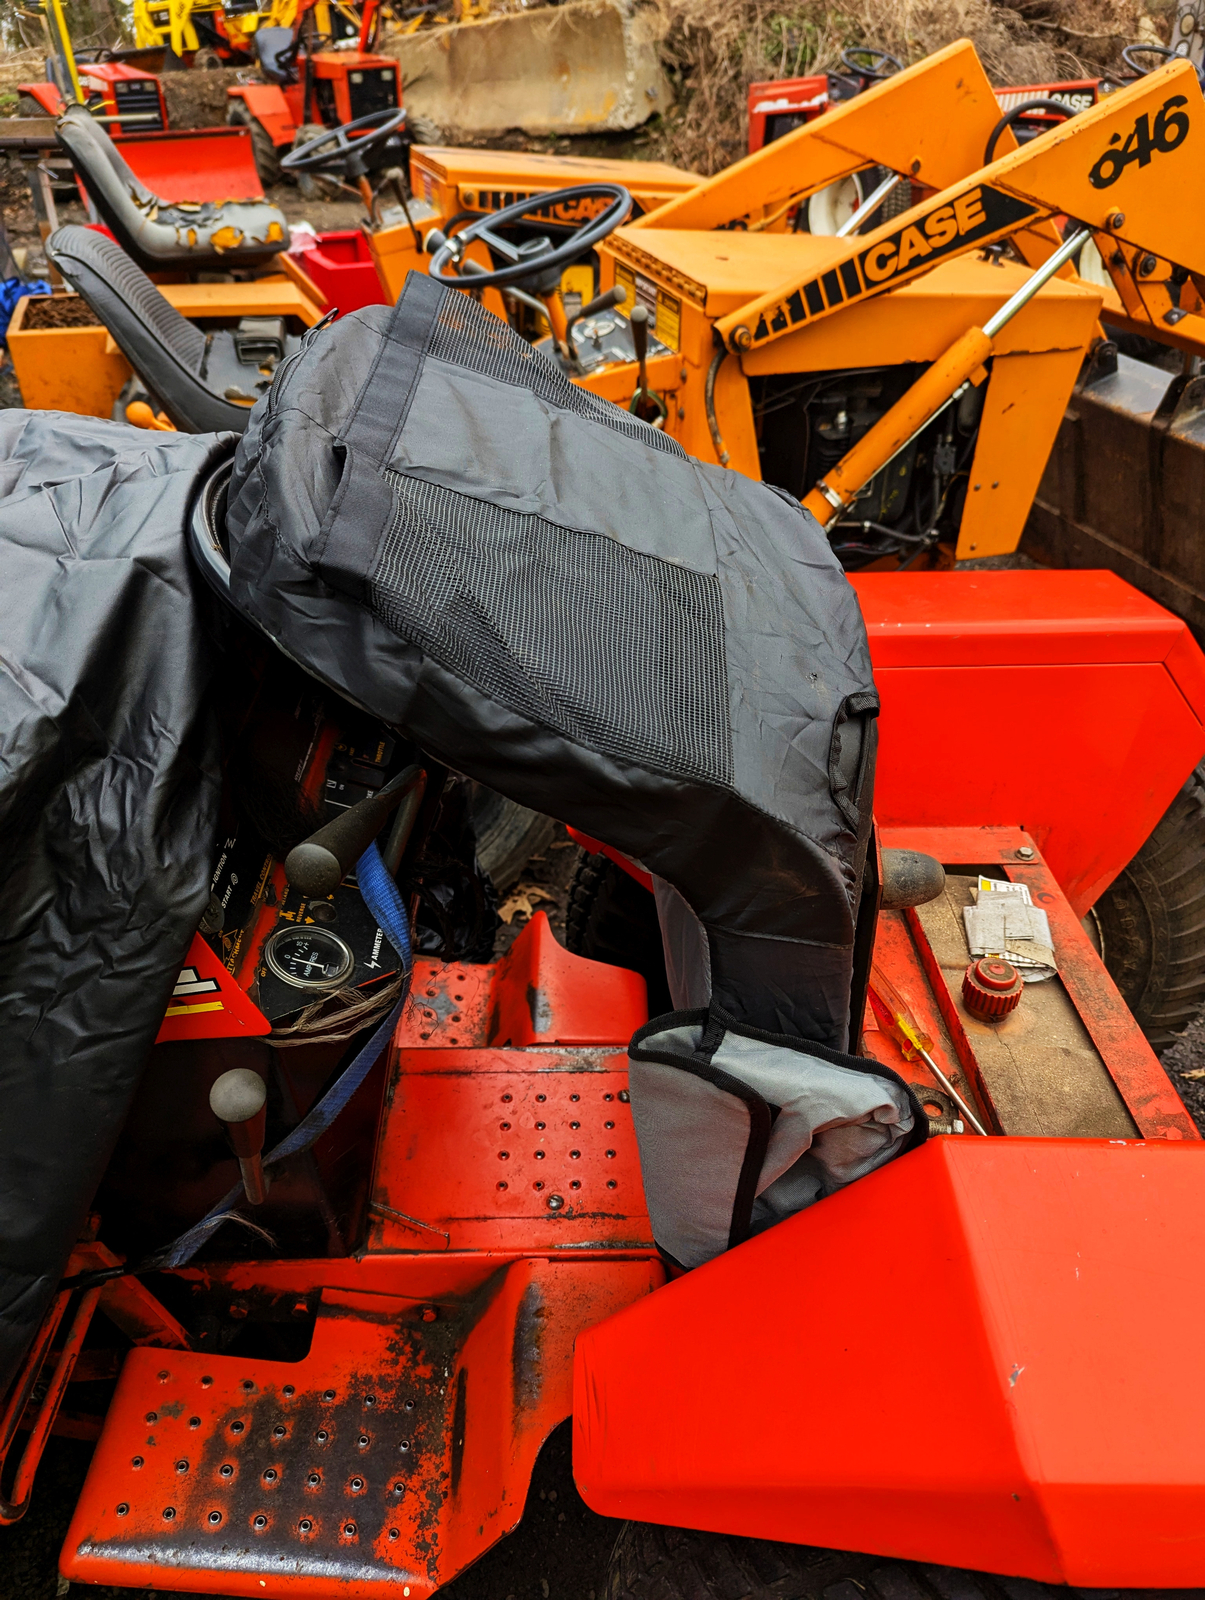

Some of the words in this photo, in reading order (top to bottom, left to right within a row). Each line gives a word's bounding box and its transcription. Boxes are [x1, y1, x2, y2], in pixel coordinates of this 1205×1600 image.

[1048, 93, 1093, 113] CASE
[1088, 95, 1189, 190] 646
[555, 197, 614, 220] CAS
[864, 188, 987, 282] CASE
[375, 741, 386, 763] THROTTLE
[213, 852, 227, 883] IGNITION
[250, 881, 262, 906] TRAVEL
[260, 853, 272, 881] CONTROL
[221, 885, 232, 909] START
[296, 902, 306, 922] REVERSE
[371, 927, 384, 961] AMMETER
[303, 951, 319, 977] AMPRES
